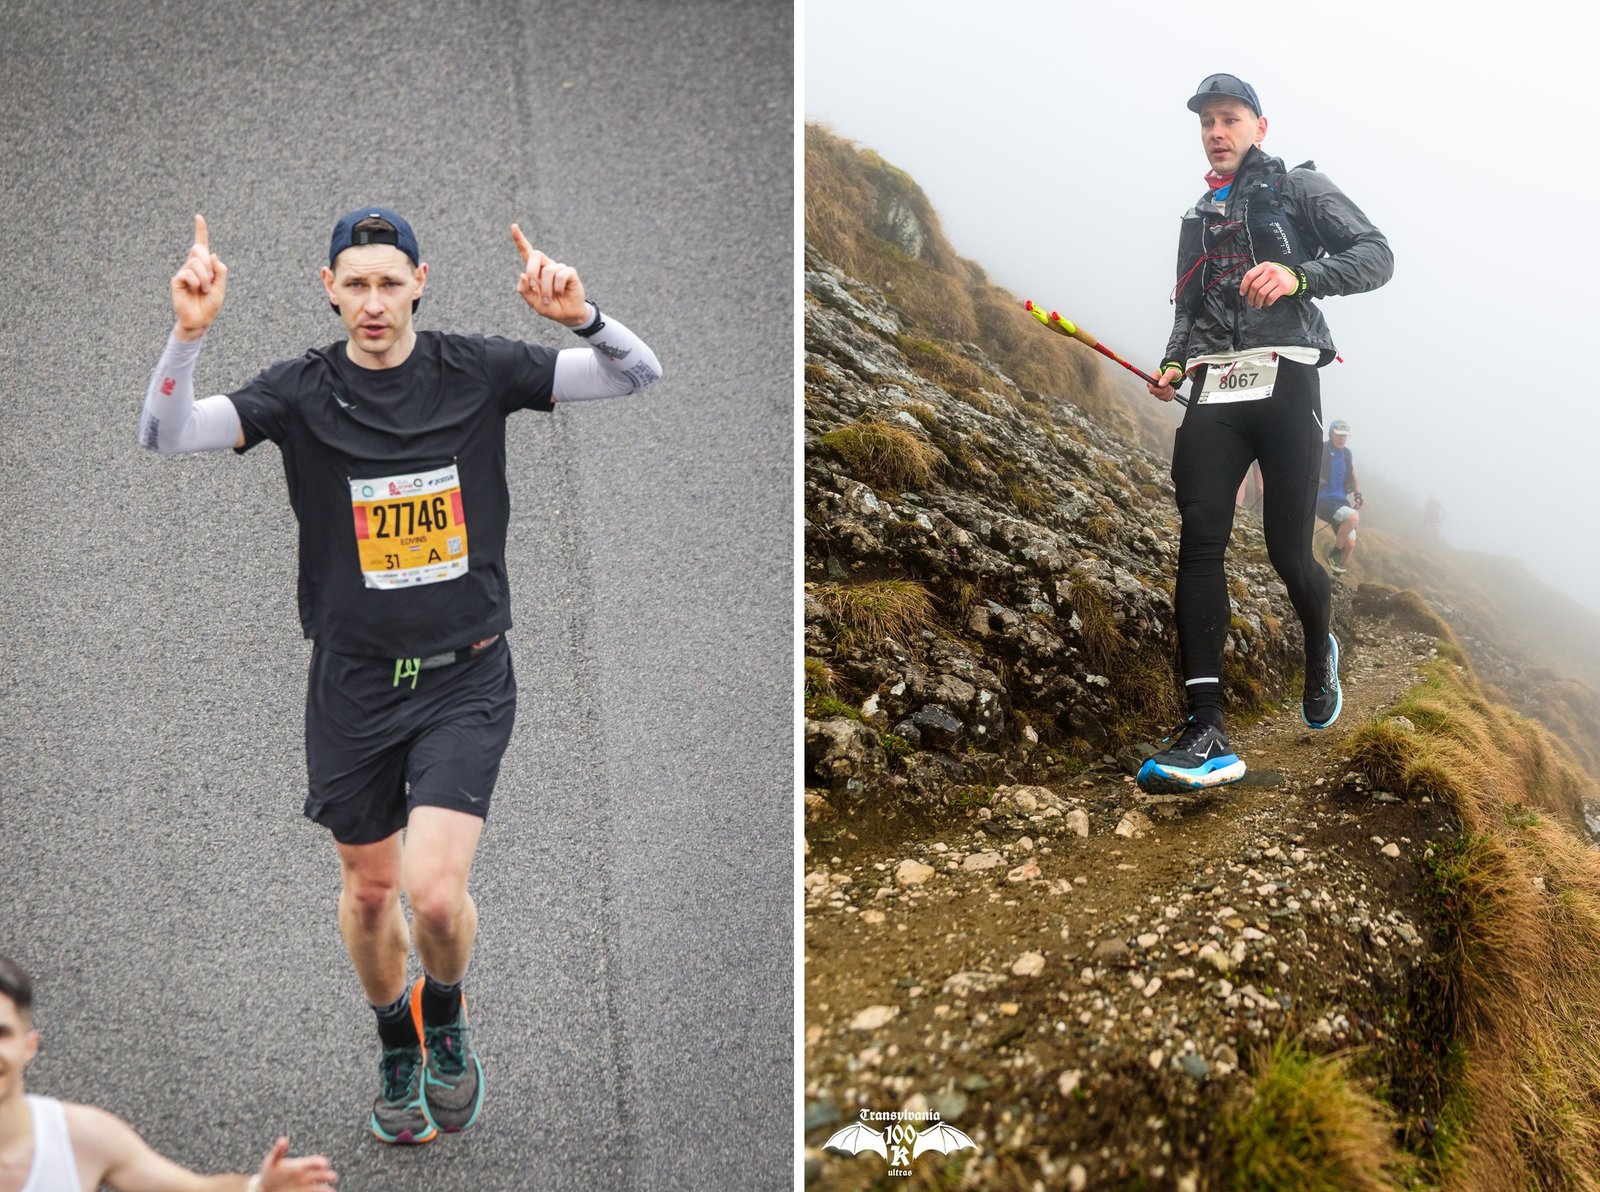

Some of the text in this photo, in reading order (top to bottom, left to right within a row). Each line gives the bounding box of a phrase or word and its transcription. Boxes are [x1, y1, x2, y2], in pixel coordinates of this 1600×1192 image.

[1269, 222, 1288, 255] ULTRA
[1274, 222, 1292, 254] SALOMON
[1219, 373, 1259, 389] 8067
[373, 497, 447, 538] 27746
[400, 535, 427, 546] EDVINS
[385, 548, 442, 569] 31 A
